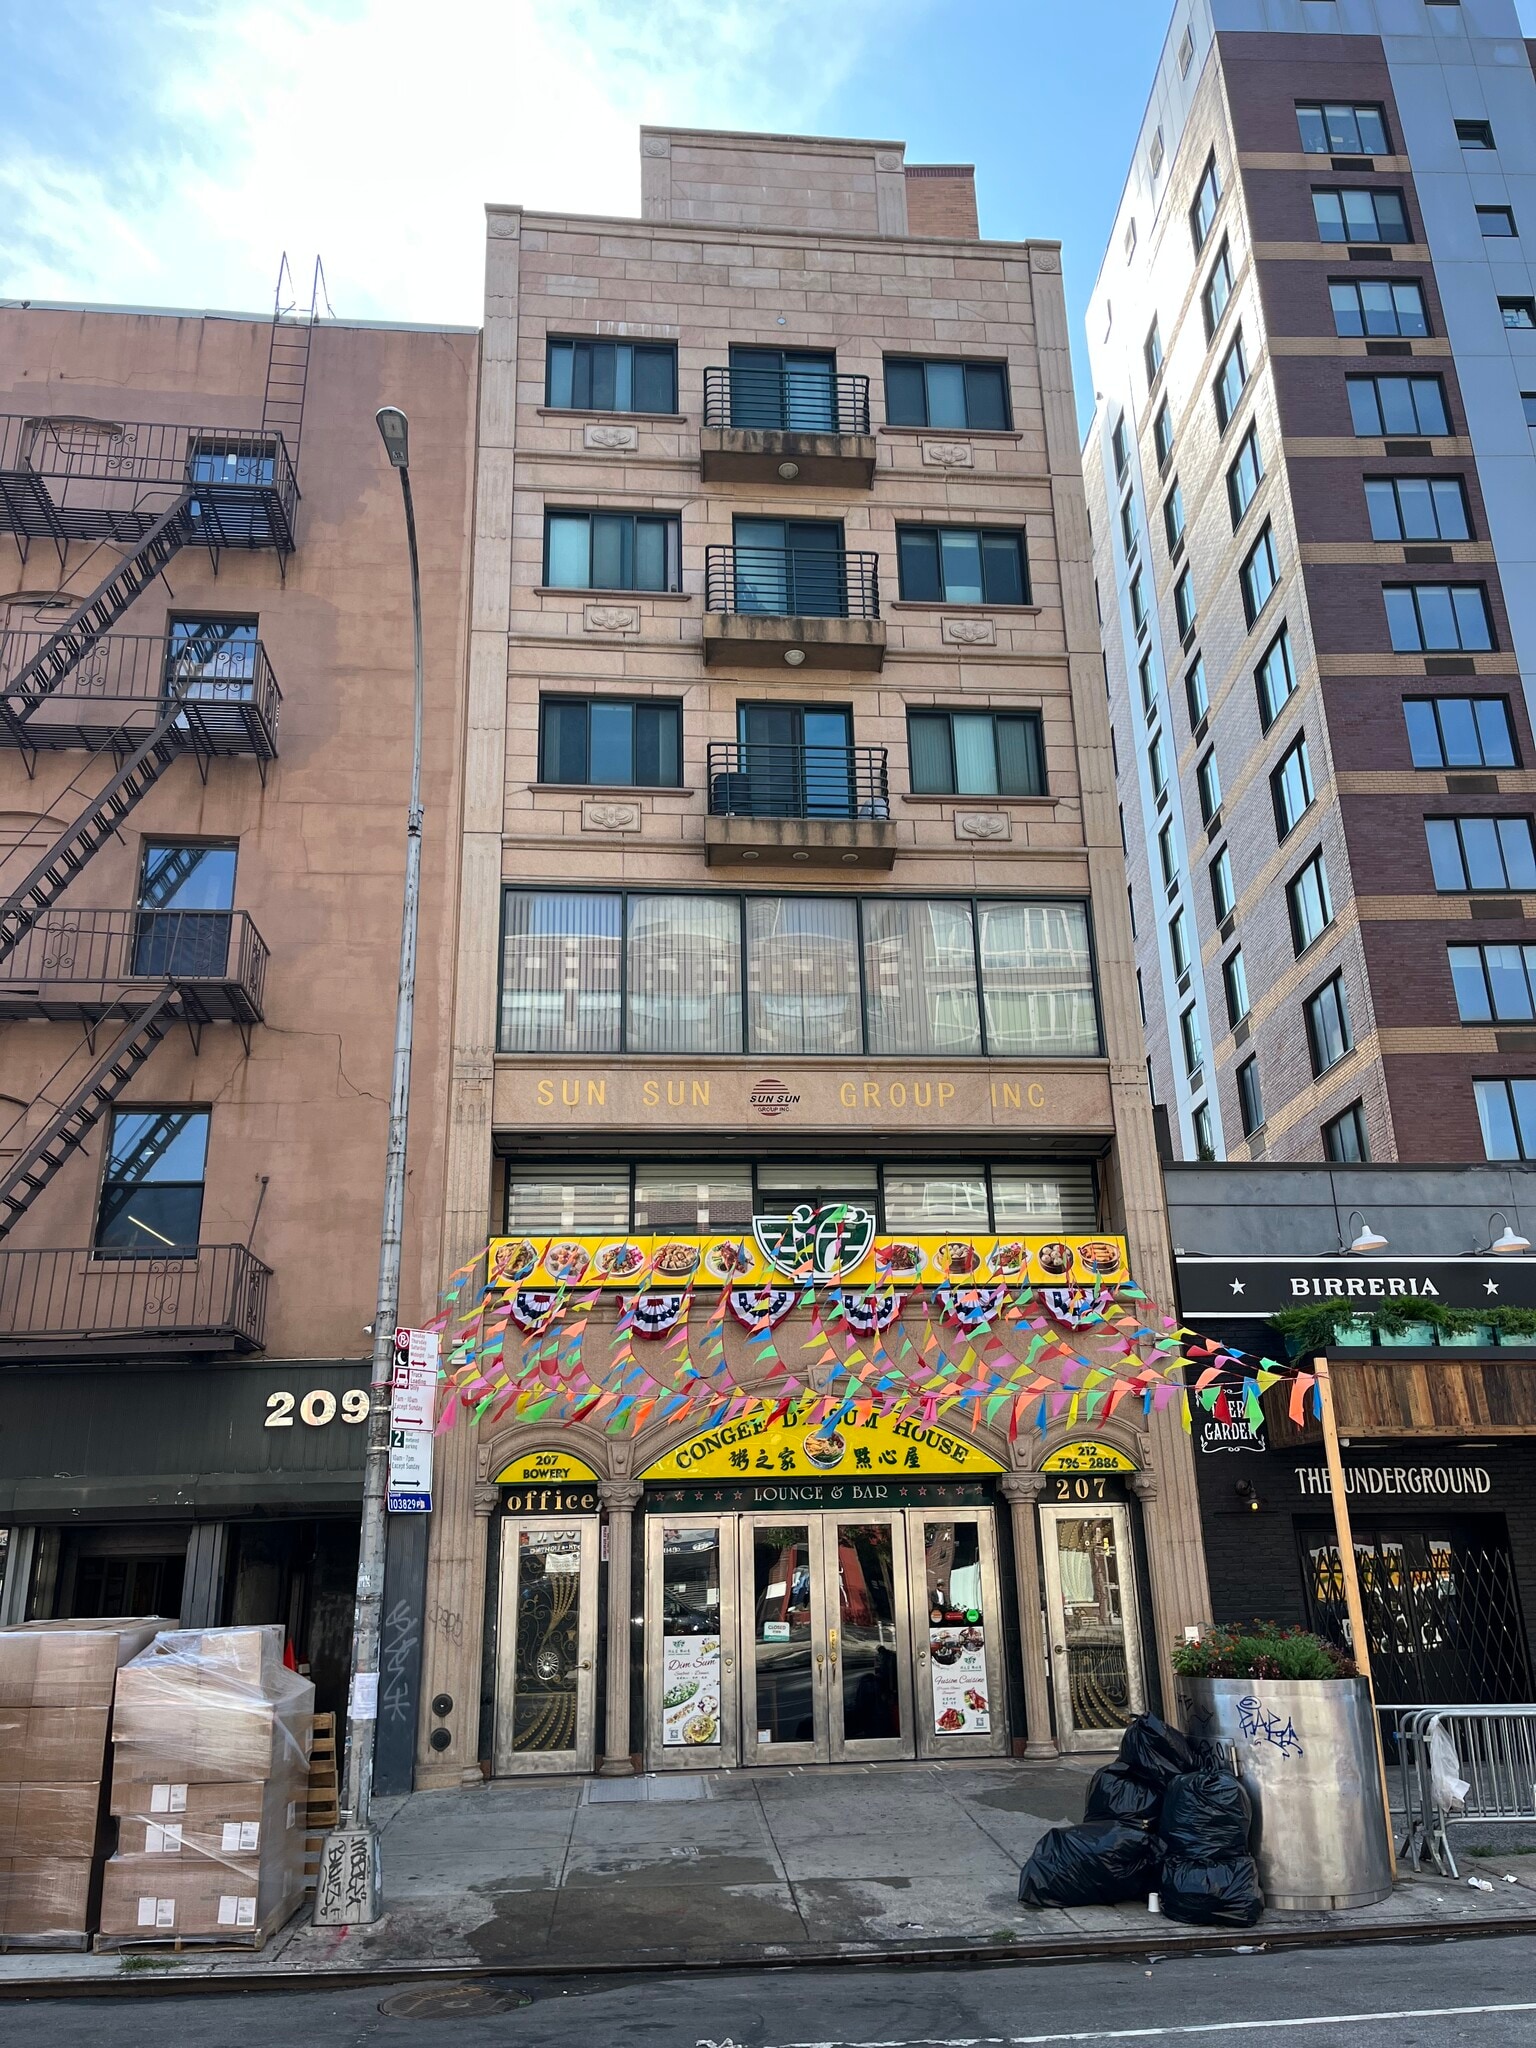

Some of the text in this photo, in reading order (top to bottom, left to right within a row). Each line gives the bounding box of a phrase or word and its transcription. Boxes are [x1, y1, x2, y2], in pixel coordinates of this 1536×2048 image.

[537, 1079, 1056, 1108] SUN SUN GROUP INC.
[750, 1095, 801, 1103] SUN SUN
[1290, 1277, 1440, 1296] BIRRERIA
[410, 1377, 427, 1385] Loading
[264, 1389, 370, 1427] 209
[394, 1402, 423, 1412] Except Sunday
[394, 1431, 402, 1446] 2
[676, 1418, 768, 1469] CONGEE
[892, 1420, 970, 1464] HOUSE
[729, 1446, 796, 1471] 粥之家
[853, 1446, 921, 1469] 點心屋
[1078, 1446, 1098, 1456] 212
[535, 1455, 559, 1466] 207
[523, 1468, 571, 1479] BOWERY
[1294, 1467, 1492, 1494] THE UNDERGROUND
[754, 1485, 889, 1501] LOUNGE & BAR
[1056, 1477, 1107, 1500] 207
[390, 1498, 416, 1509] 103829
[507, 1489, 595, 1511] office
[668, 1657, 717, 1671] Dim Sum
[934, 1674, 985, 1686] Fusion Cuisine
